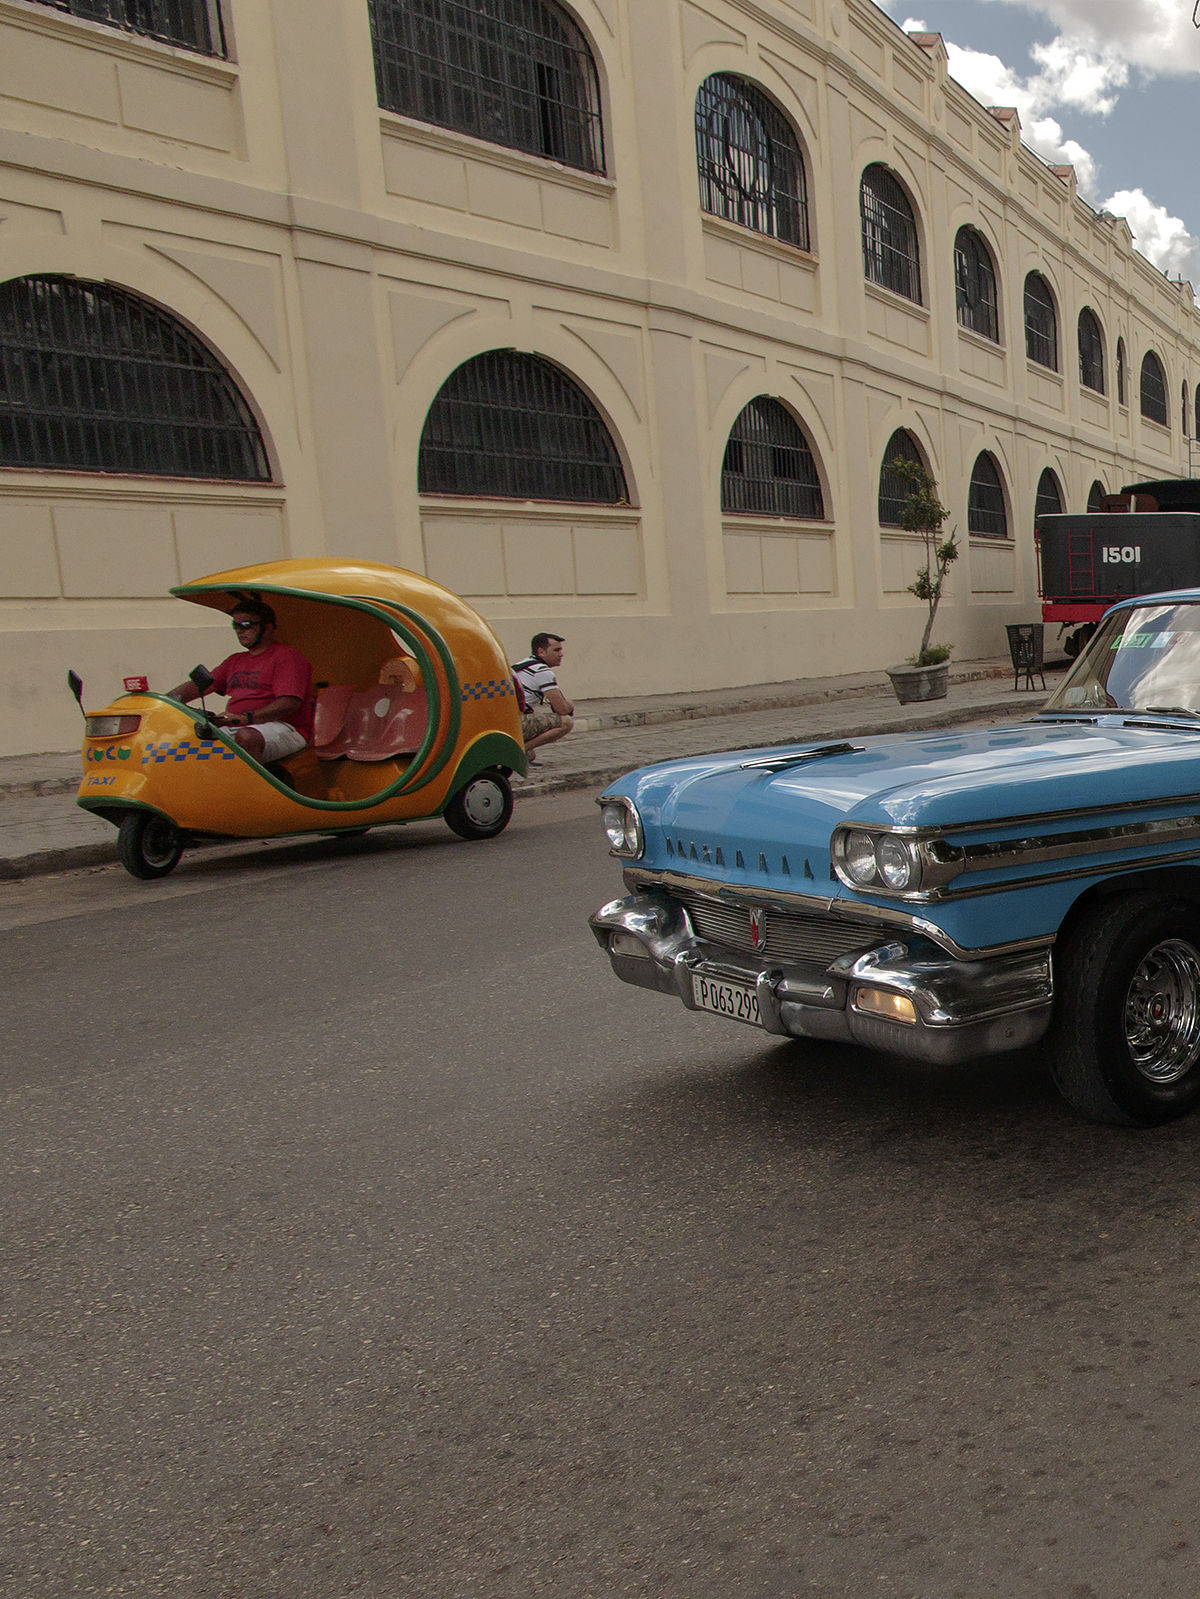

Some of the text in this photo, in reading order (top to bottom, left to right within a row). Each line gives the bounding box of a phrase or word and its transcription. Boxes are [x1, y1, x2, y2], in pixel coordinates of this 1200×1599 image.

[1102, 546, 1141, 563] 1501
[86, 745, 132, 762] COCO
[87, 776, 117, 786] TAXI
[700, 979, 760, 1021] P063299
